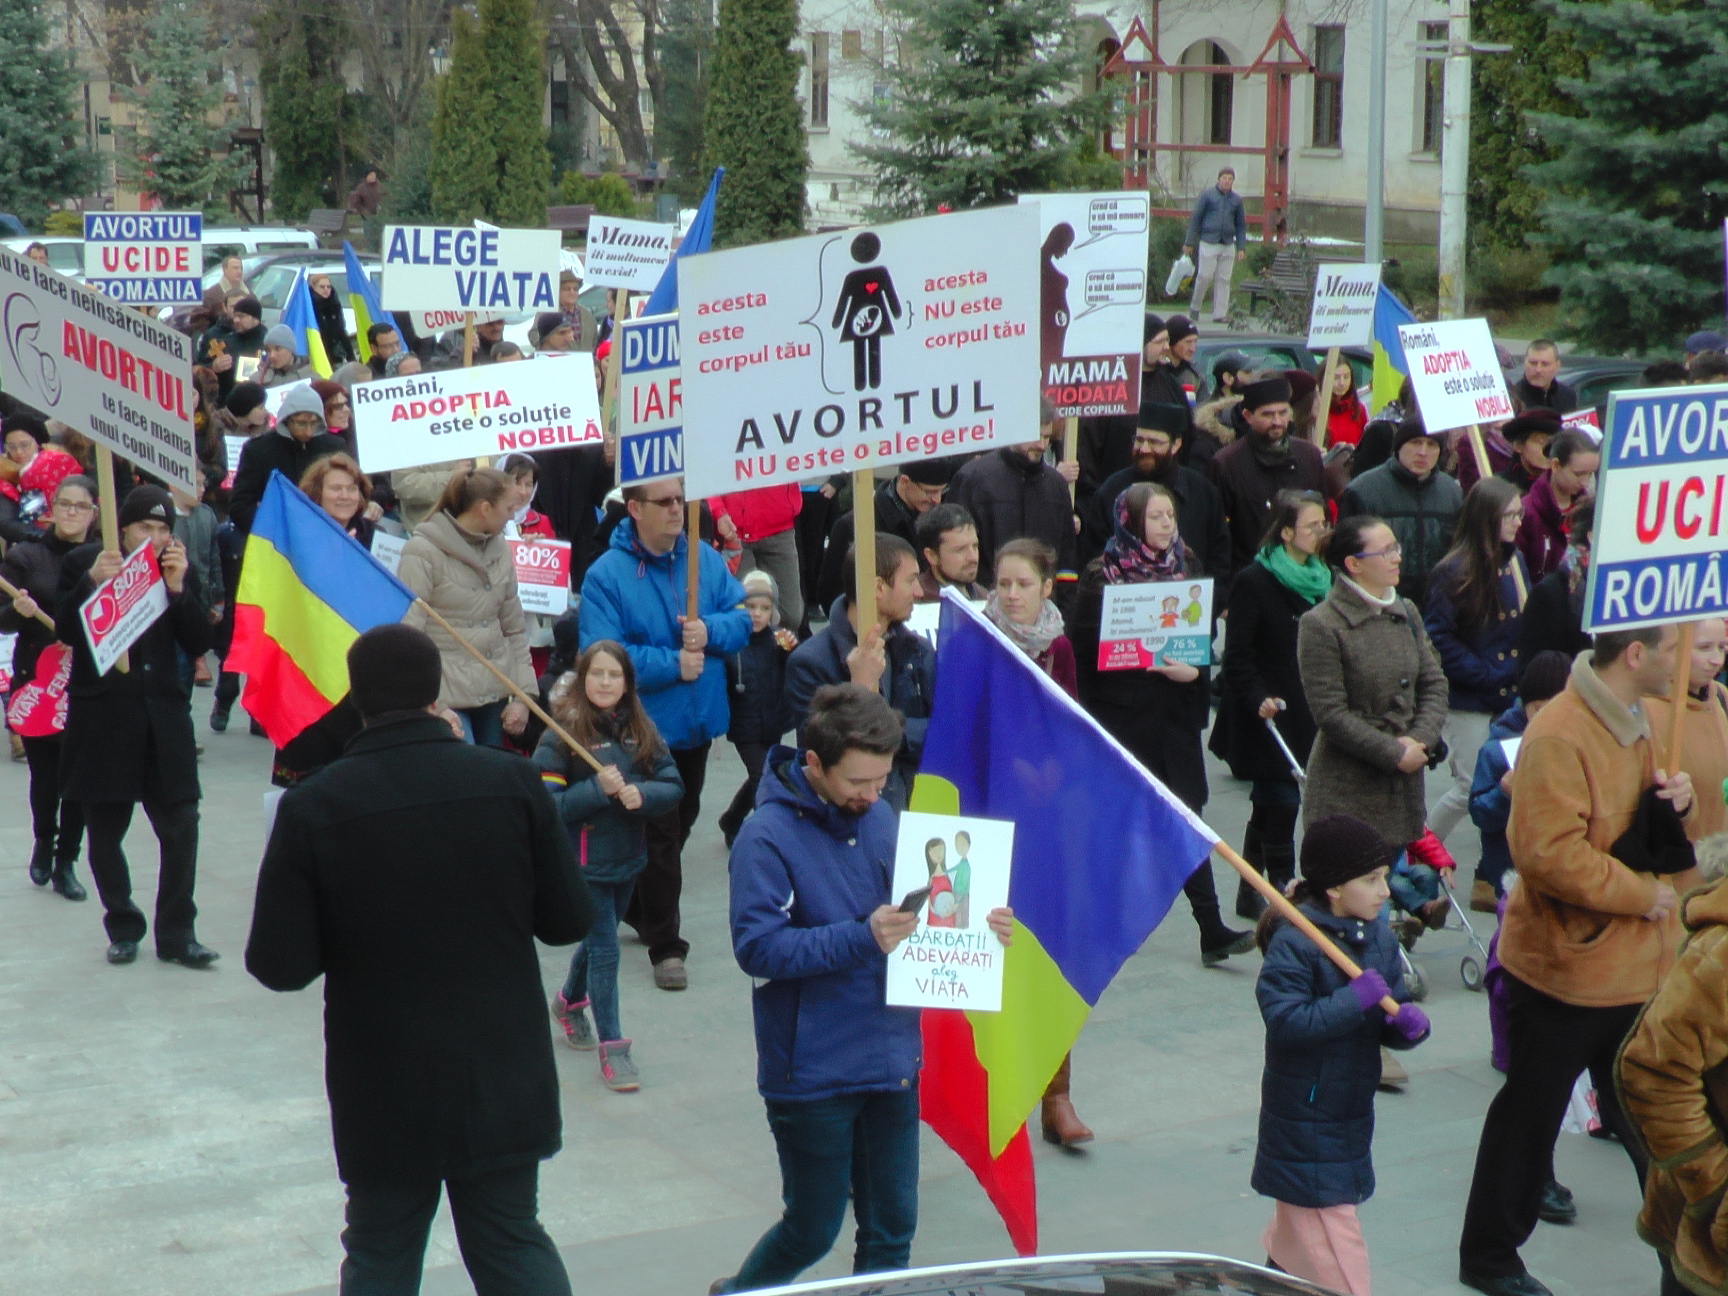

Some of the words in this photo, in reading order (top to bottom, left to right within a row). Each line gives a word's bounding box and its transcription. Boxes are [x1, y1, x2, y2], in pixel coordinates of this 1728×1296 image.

[91, 216, 197, 239] AVORTUL
[102, 246, 189, 273] UCIDE
[387, 227, 499, 266] ALEGE
[0, 254, 12, 273] u
[14, 257, 31, 281] te
[33, 265, 68, 300] face
[924, 269, 988, 292] acesta
[697, 291, 767, 316] acesta
[925, 300, 955, 321] NU
[960, 296, 1003, 314] este
[698, 325, 744, 344] este
[925, 323, 988, 349] corpul
[993, 320, 1026, 339] tău
[63, 318, 190, 422] AVORTUL
[699, 344, 769, 373] corpul
[775, 341, 811, 360] tău
[1048, 356, 1128, 385] MAMĂ
[356, 376, 444, 404] Români,
[1444, 377, 1463, 395] este
[1463, 378, 1470, 392] o
[391, 389, 512, 422] ADOPȚIA
[429, 415, 474, 436] este
[479, 414, 492, 428] o
[498, 403, 572, 426] soluție
[735, 379, 995, 454] AVORTUL
[1056, 406, 1082, 417] CIDE
[1083, 404, 1126, 415] COPILUL
[102, 392, 116, 414] te
[118, 399, 148, 431] face
[150, 420, 192, 457] mama
[497, 418, 603, 451] NOBILĂ
[90, 413, 119, 443] unui
[158, 452, 194, 487] mort.
[734, 455, 777, 481] NU
[785, 446, 845, 472] este
[854, 443, 870, 460] o
[878, 418, 994, 456] alegere!
[515, 545, 560, 569] 80%
[113, 552, 149, 600] 80%
[1602, 551, 1728, 620] ROMÂ
[1113, 643, 1125, 653] 24
[931, 965, 958, 981] aleg
